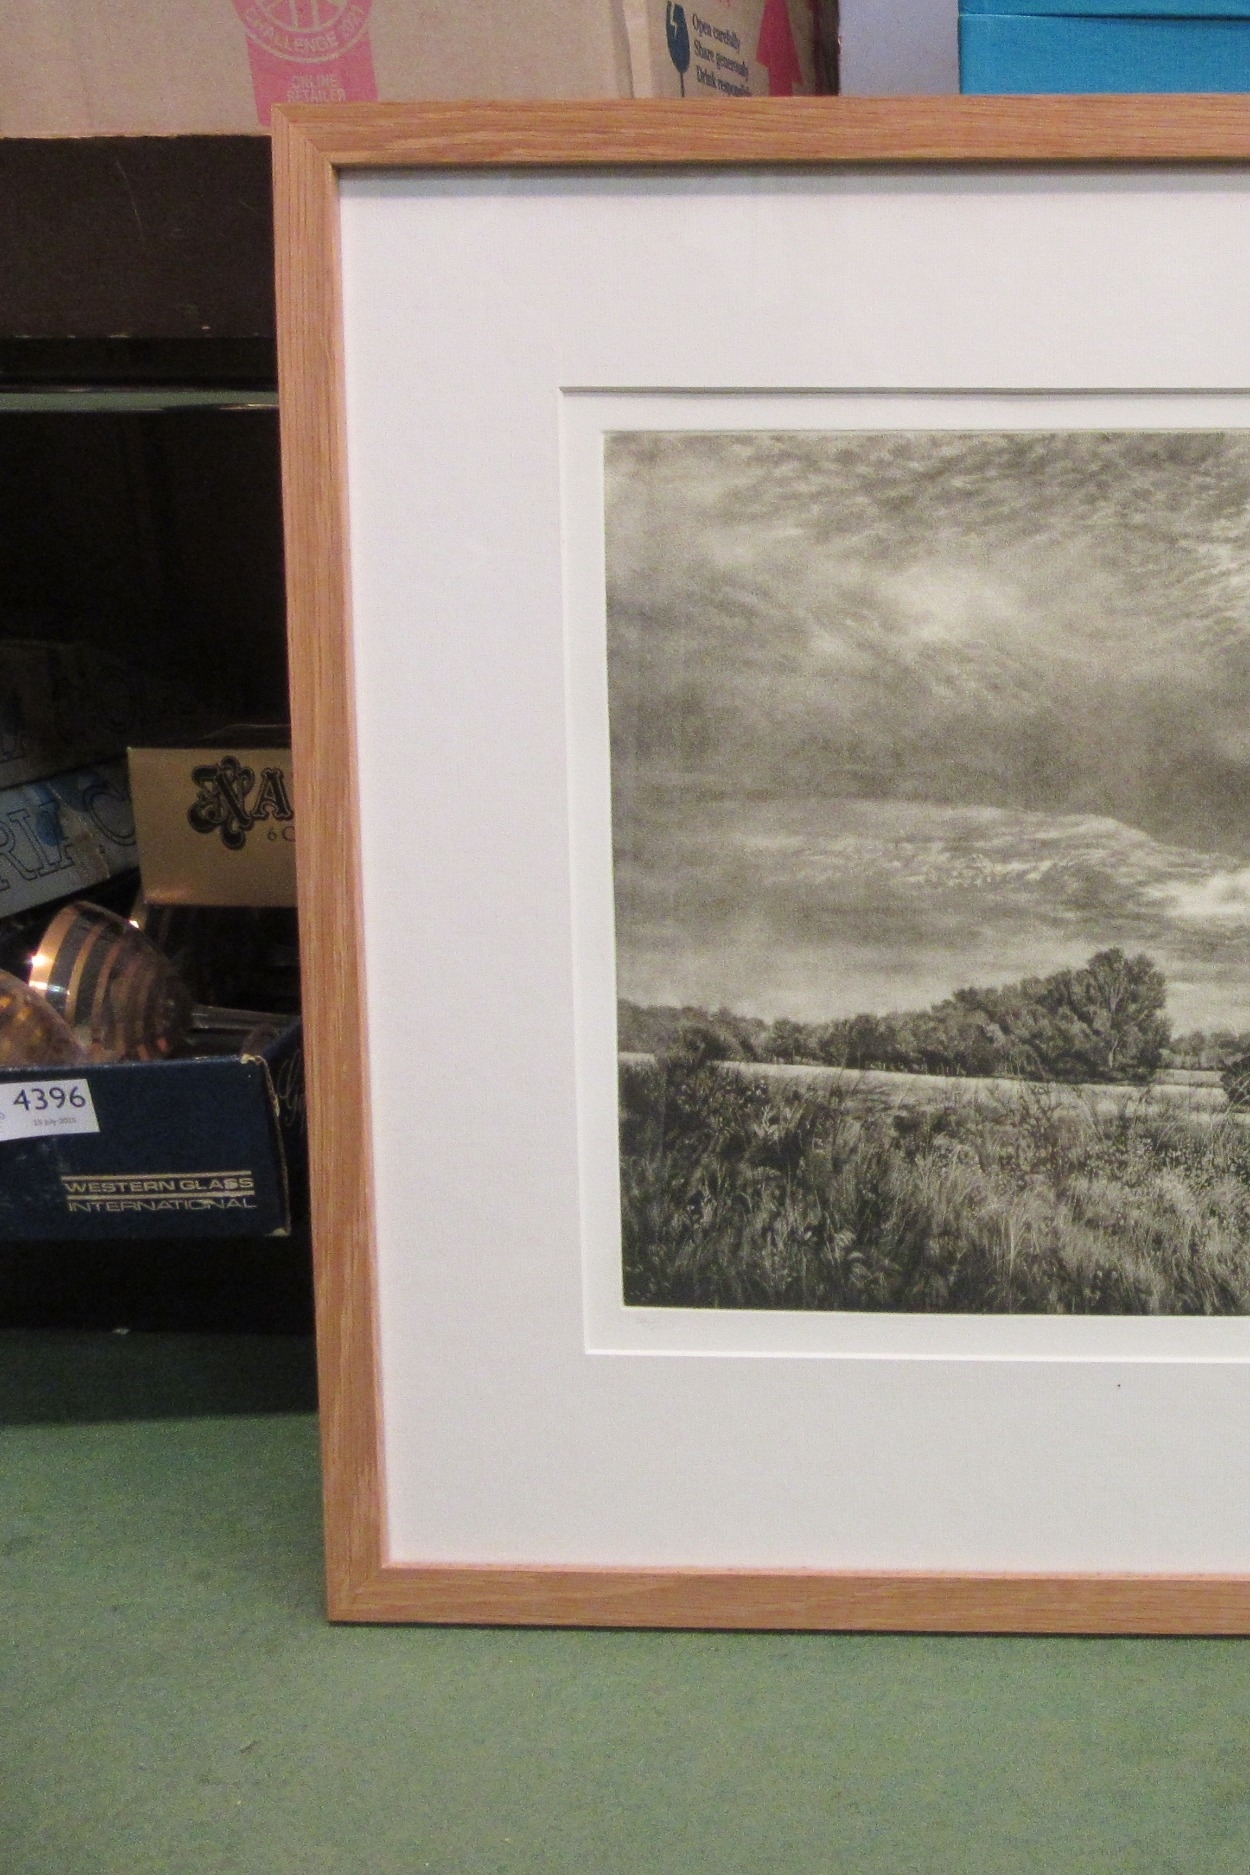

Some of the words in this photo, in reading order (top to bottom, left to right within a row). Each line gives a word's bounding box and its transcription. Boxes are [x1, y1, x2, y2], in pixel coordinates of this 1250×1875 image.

[13, 1085, 87, 1111] 4396
[64, 1179, 176, 1194] WESTERN
[179, 1176, 255, 1192] GLASS
[67, 1197, 258, 1213] INTERNATIONAL
